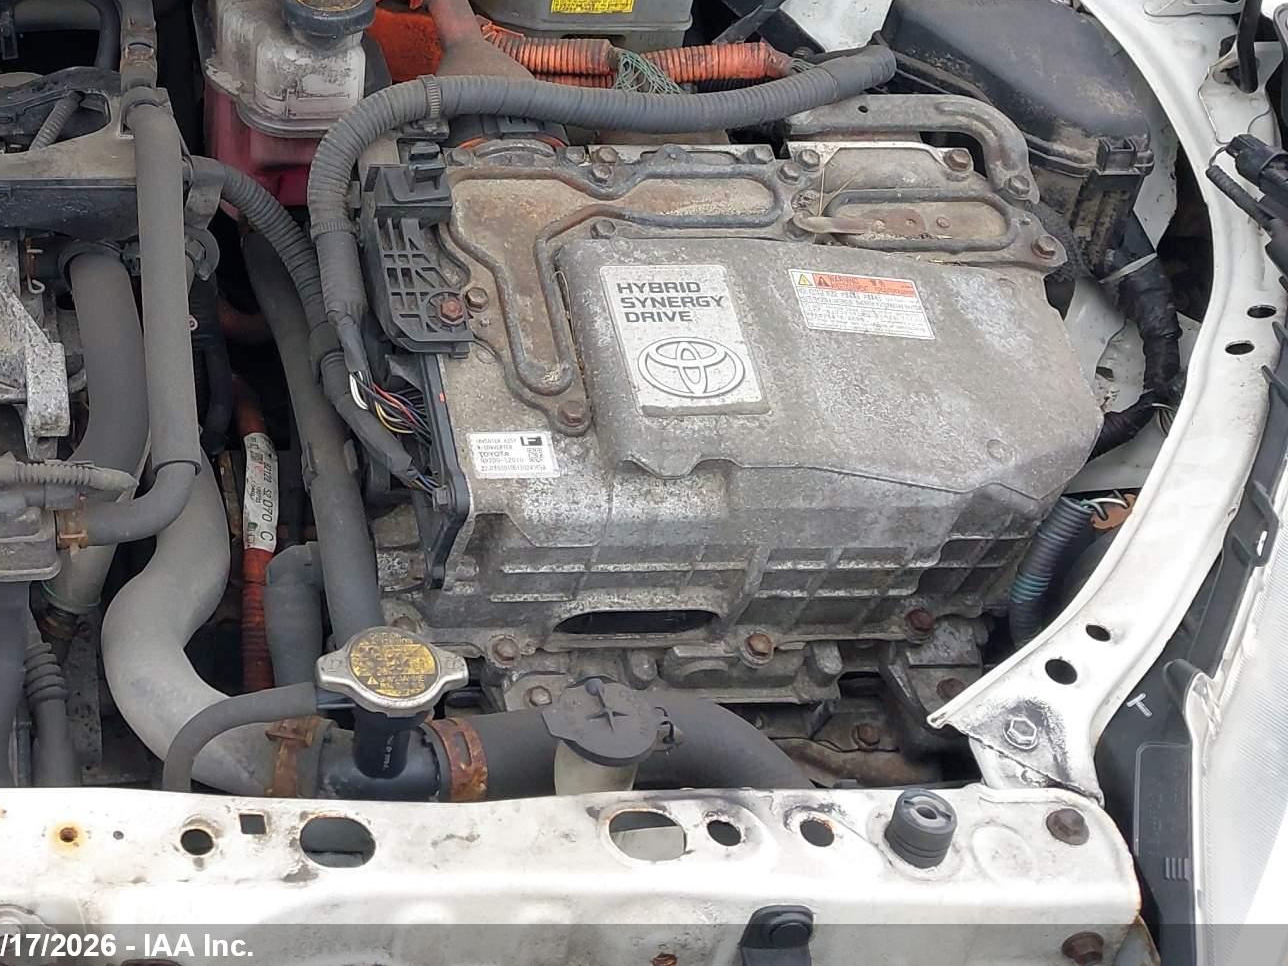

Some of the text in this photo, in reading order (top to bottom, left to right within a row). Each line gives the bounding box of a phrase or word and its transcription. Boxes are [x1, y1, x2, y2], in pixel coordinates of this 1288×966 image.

[616, 281, 701, 294] HYBRID
[620, 295, 724, 309] SYNERGY
[624, 310, 693, 323] DRIVE
